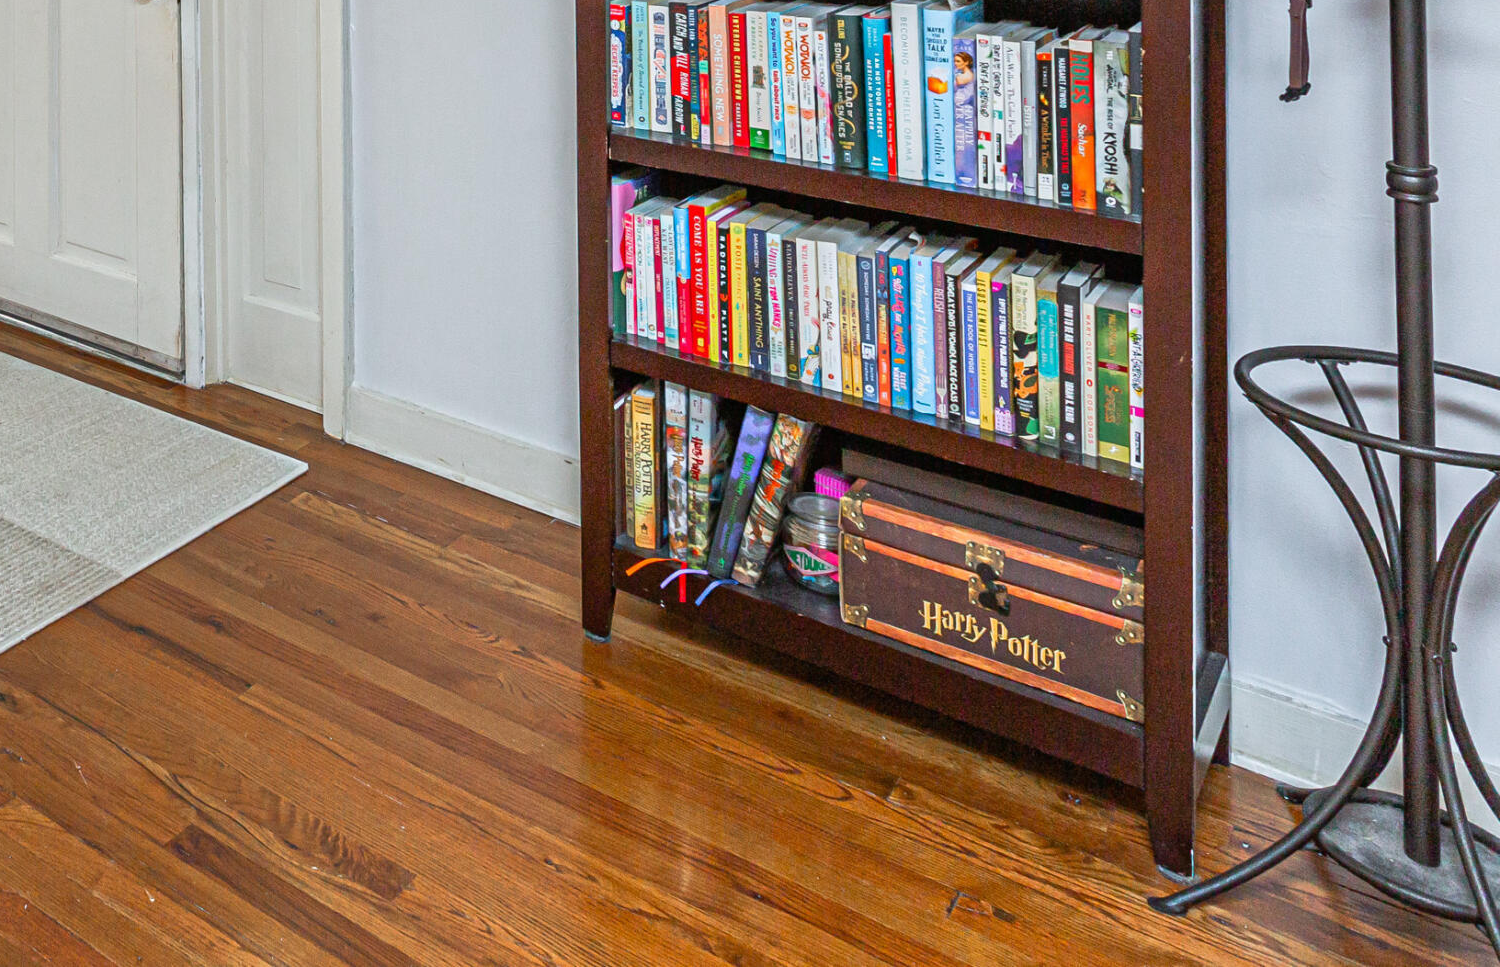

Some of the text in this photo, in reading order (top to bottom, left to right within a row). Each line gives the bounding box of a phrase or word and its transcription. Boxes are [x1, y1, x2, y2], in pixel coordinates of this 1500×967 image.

[673, 13, 688, 68] CATCH AND KILL
[732, 16, 741, 51] INTERIOR
[771, 18, 777, 26] So
[900, 17, 908, 65] BECOMING
[612, 44, 623, 97] SECRET KEEPERS
[713, 34, 724, 122] SOMETHING NEW
[800, 35, 811, 81] WOTAKOI:
[835, 43, 843, 88] SONGBIRDS
[875, 58, 880, 68] AM
[680, 72, 689, 96] RONAN
[674, 95, 683, 123] FARROW
[955, 95, 965, 151] EVER AFTER
[965, 105, 973, 146] HAPPILY
[1072, 55, 1089, 157] HOLES Sachar
[934, 98, 947, 165] Lori Gottlieb
[1104, 132, 1117, 174] KYOSHI
[695, 250, 702, 264] AS
[695, 268, 703, 289] YOU
[753, 277, 761, 301] SAINT
[915, 284, 927, 312] Things
[769, 286, 781, 328] TOM HANKS
[935, 288, 944, 312] RELISH
[978, 280, 988, 347] JESUS FEMINIST
[1064, 305, 1073, 317] HOW
[755, 303, 763, 348] ANYTHING
[916, 325, 926, 344] Hate
[916, 373, 929, 395] Pinky
[640, 422, 652, 496] HARRY POTTER
[672, 435, 683, 478] Harry Potter
[691, 437, 704, 481] Harry Potter
[735, 453, 755, 495] Harry Potter
[918, 600, 1066, 674] Harry Potter
